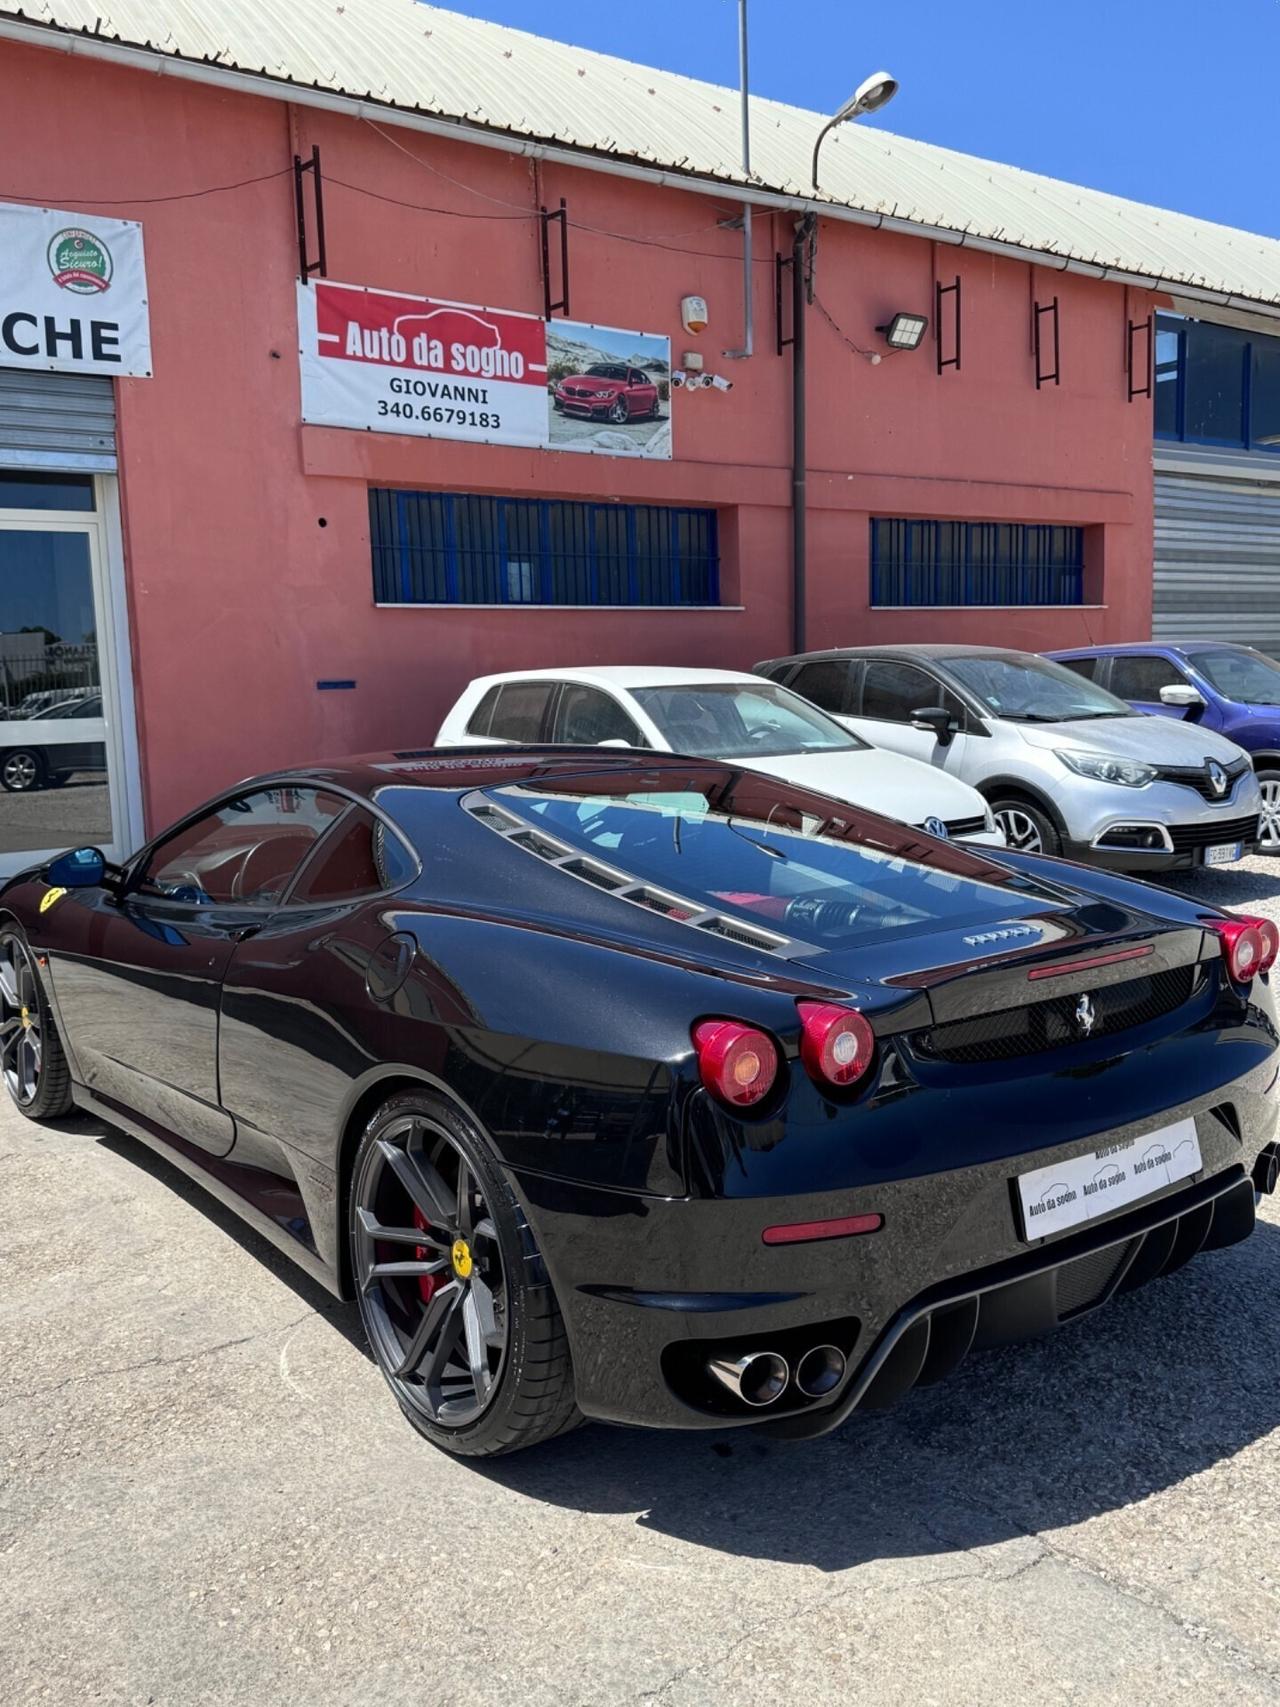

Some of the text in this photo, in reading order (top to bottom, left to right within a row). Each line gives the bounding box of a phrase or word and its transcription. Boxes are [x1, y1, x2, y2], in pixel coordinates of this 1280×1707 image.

[1, 311, 122, 362] CHE
[345, 321, 524, 379] Auto da sogno
[389, 377, 489, 404] GIOVANNI
[377, 400, 501, 430] 340.6679183
[1133, 1161, 1147, 1175] Auto
[1147, 1158, 1155, 1170] da
[1083, 1183, 1098, 1196] Auto
[1099, 1179, 1107, 1191] da
[1029, 1189, 1077, 1217] Auto da sogno
